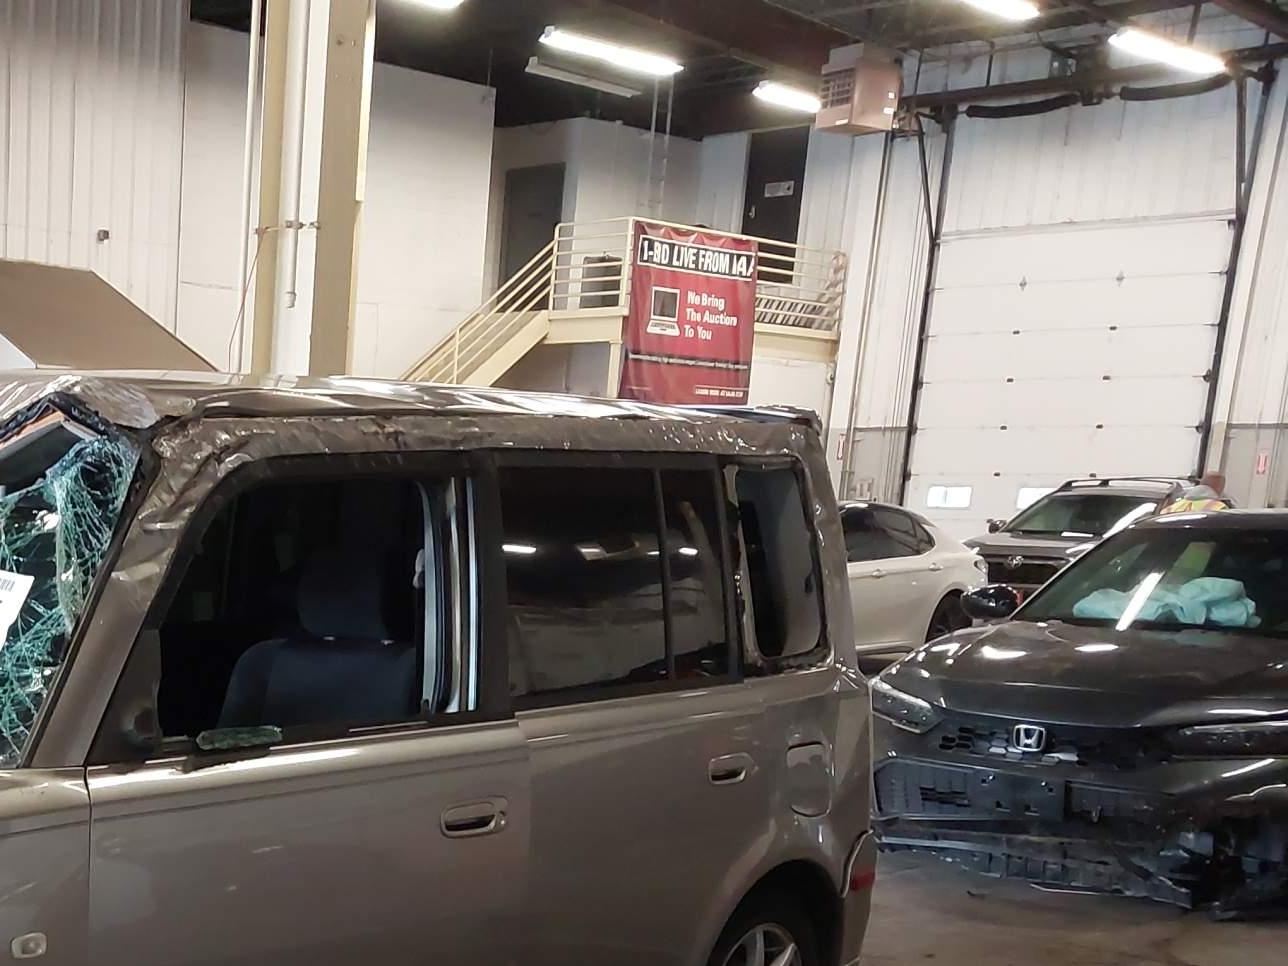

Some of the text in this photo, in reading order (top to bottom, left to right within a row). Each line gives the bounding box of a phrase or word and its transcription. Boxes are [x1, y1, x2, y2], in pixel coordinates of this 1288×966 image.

[672, 245, 697, 269] LIVE
[698, 249, 730, 274] FROM
[701, 292, 725, 311] Bring
[686, 308, 738, 326] The Auction
[684, 324, 712, 340] To You
